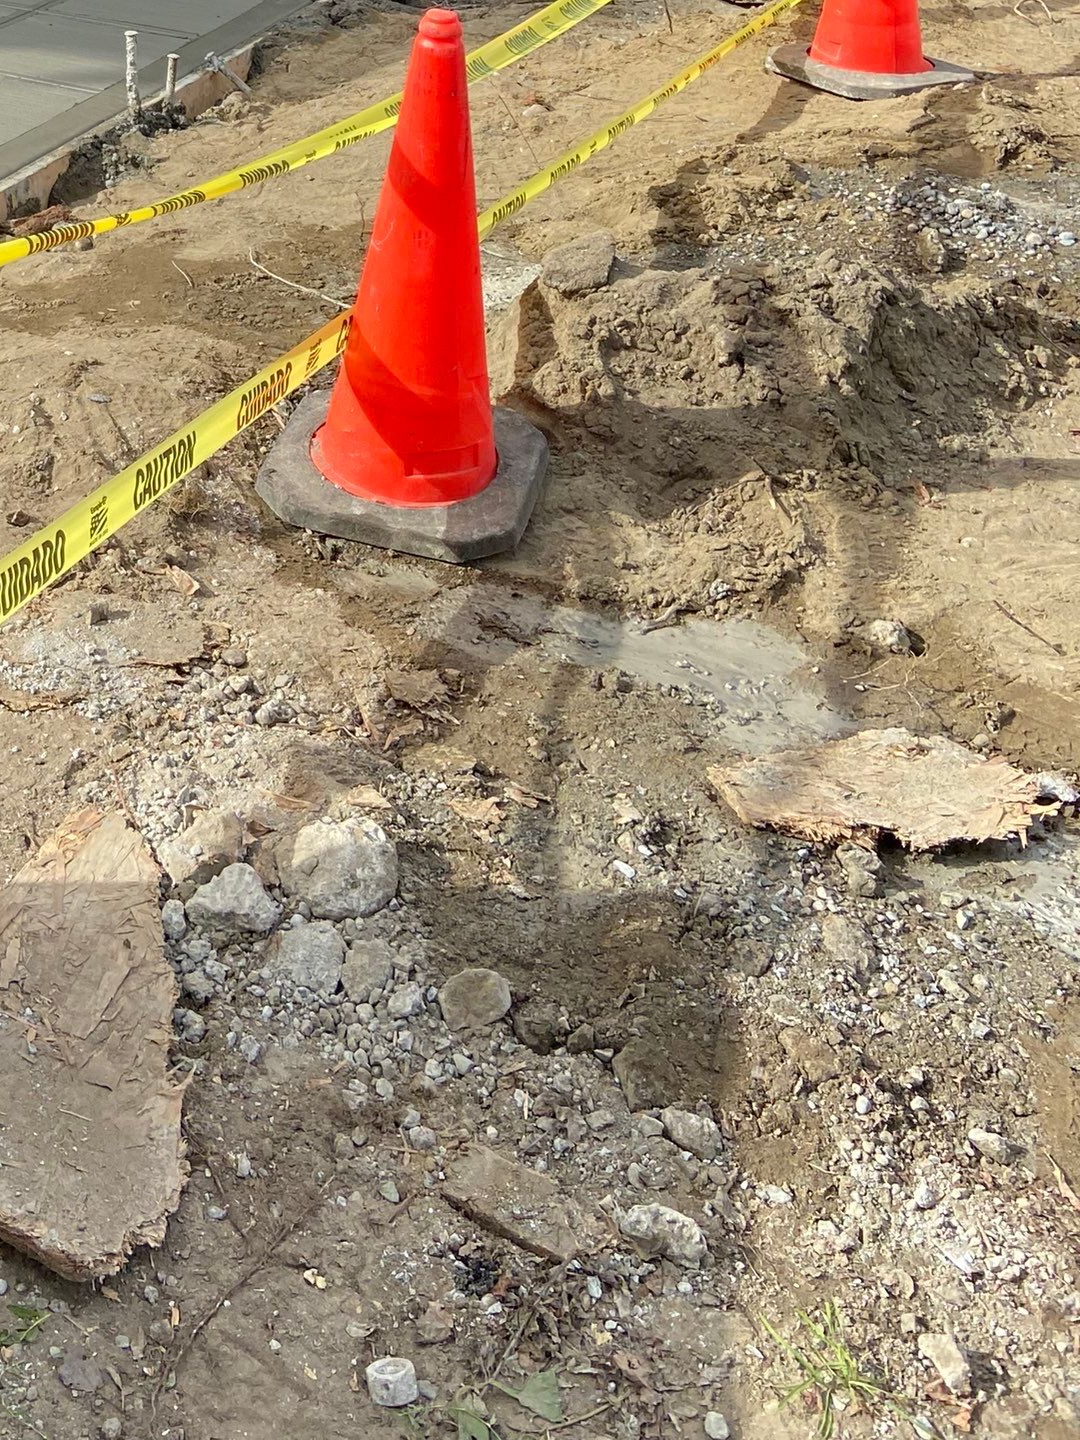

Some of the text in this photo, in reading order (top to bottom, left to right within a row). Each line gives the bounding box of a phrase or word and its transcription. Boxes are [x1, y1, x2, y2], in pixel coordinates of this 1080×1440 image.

[491, 191, 527, 228] CAUTION
[133, 431, 197, 511] CAUTION
[235, 361, 293, 432] CUIDADO
